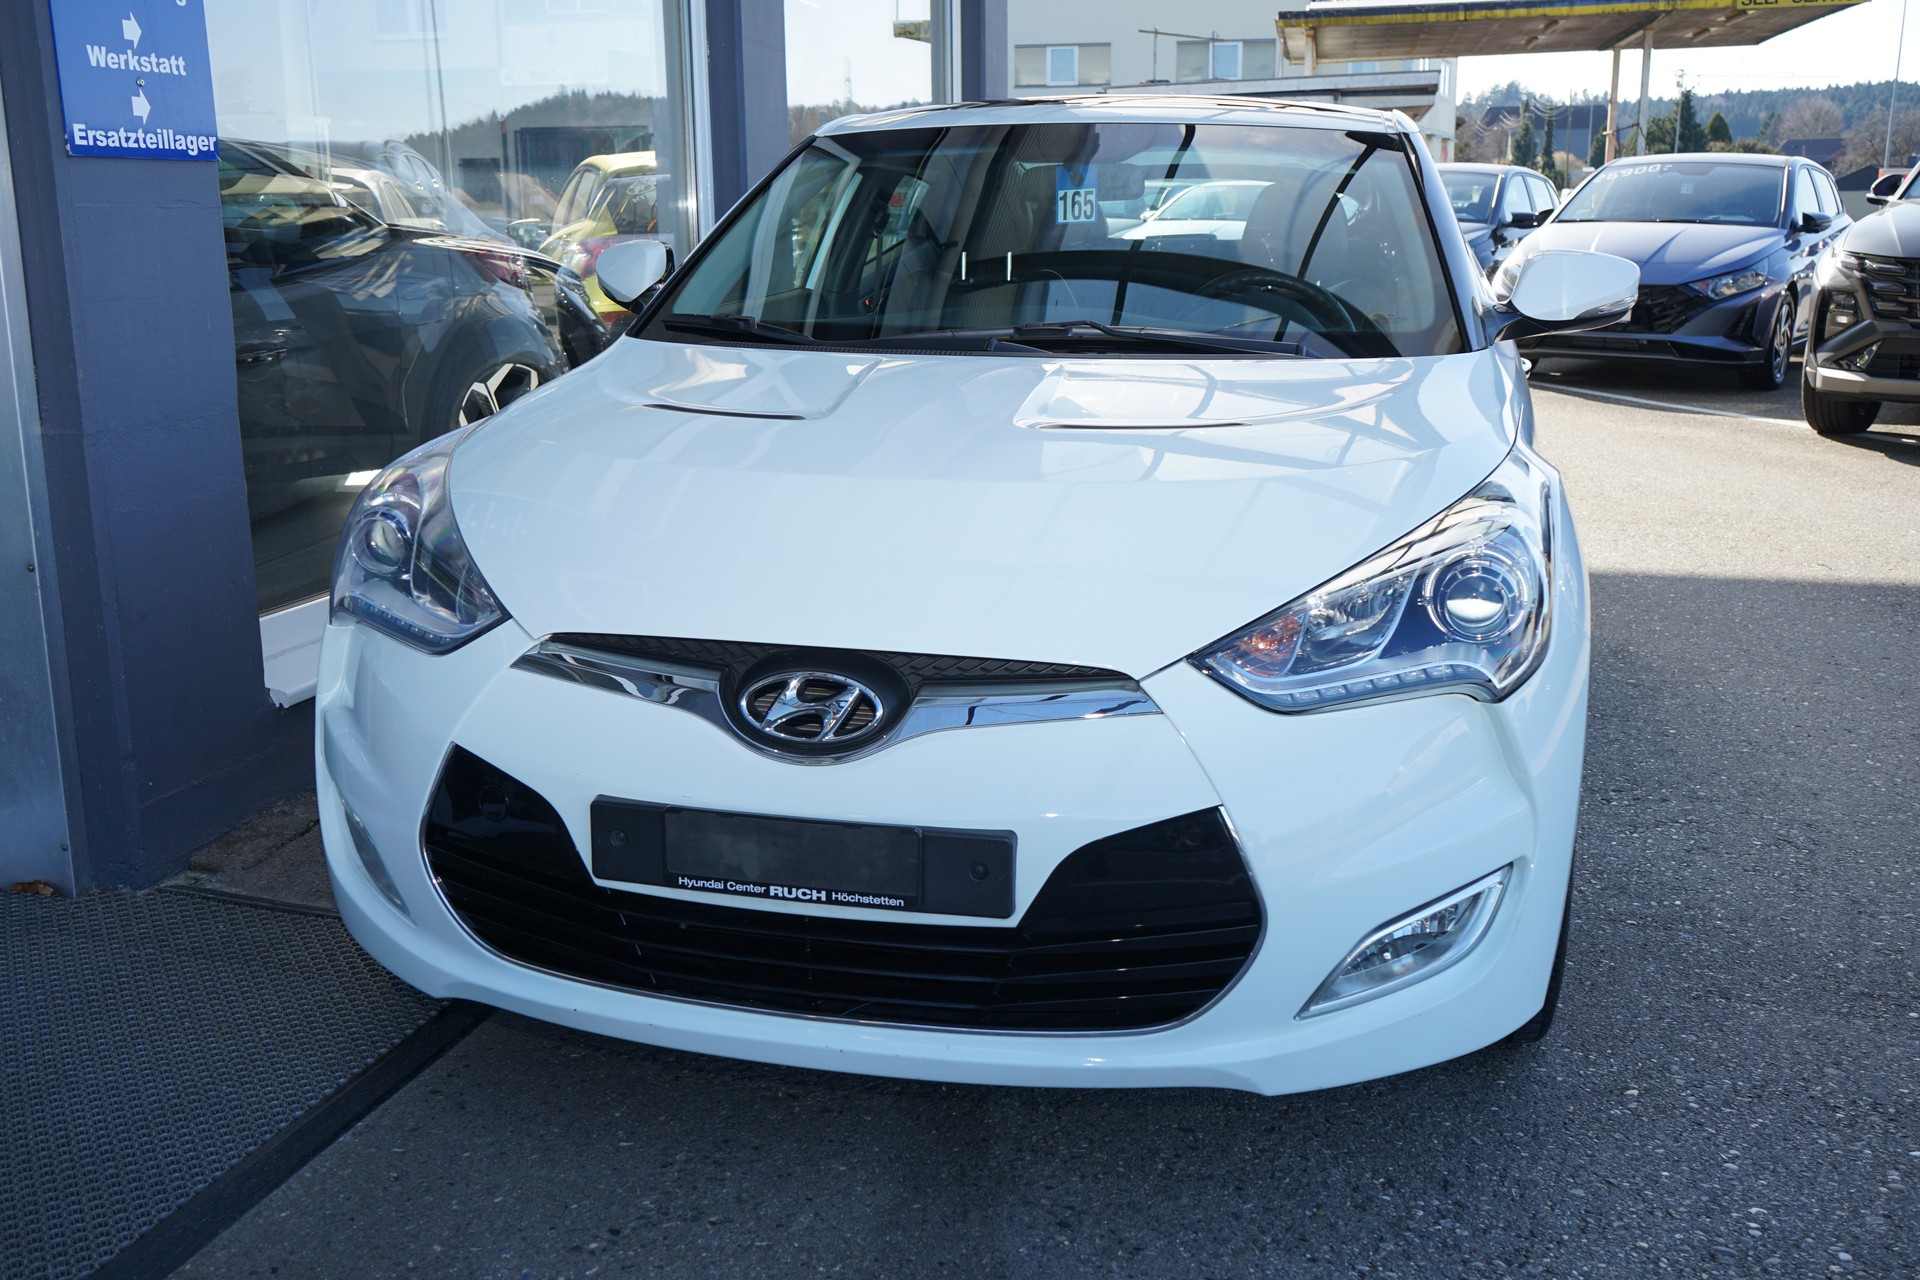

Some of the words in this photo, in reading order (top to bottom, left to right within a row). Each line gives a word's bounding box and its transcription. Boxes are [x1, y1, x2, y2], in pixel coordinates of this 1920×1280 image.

[86, 44, 186, 76] Werkstatt
[73, 123, 217, 156] Ersatzteillager
[1059, 190, 1094, 220] 165
[678, 877, 724, 889] Hyundai
[727, 882, 766, 893] Center
[769, 886, 826, 901] RUCH
[832, 892, 904, 906] Höchstetten
